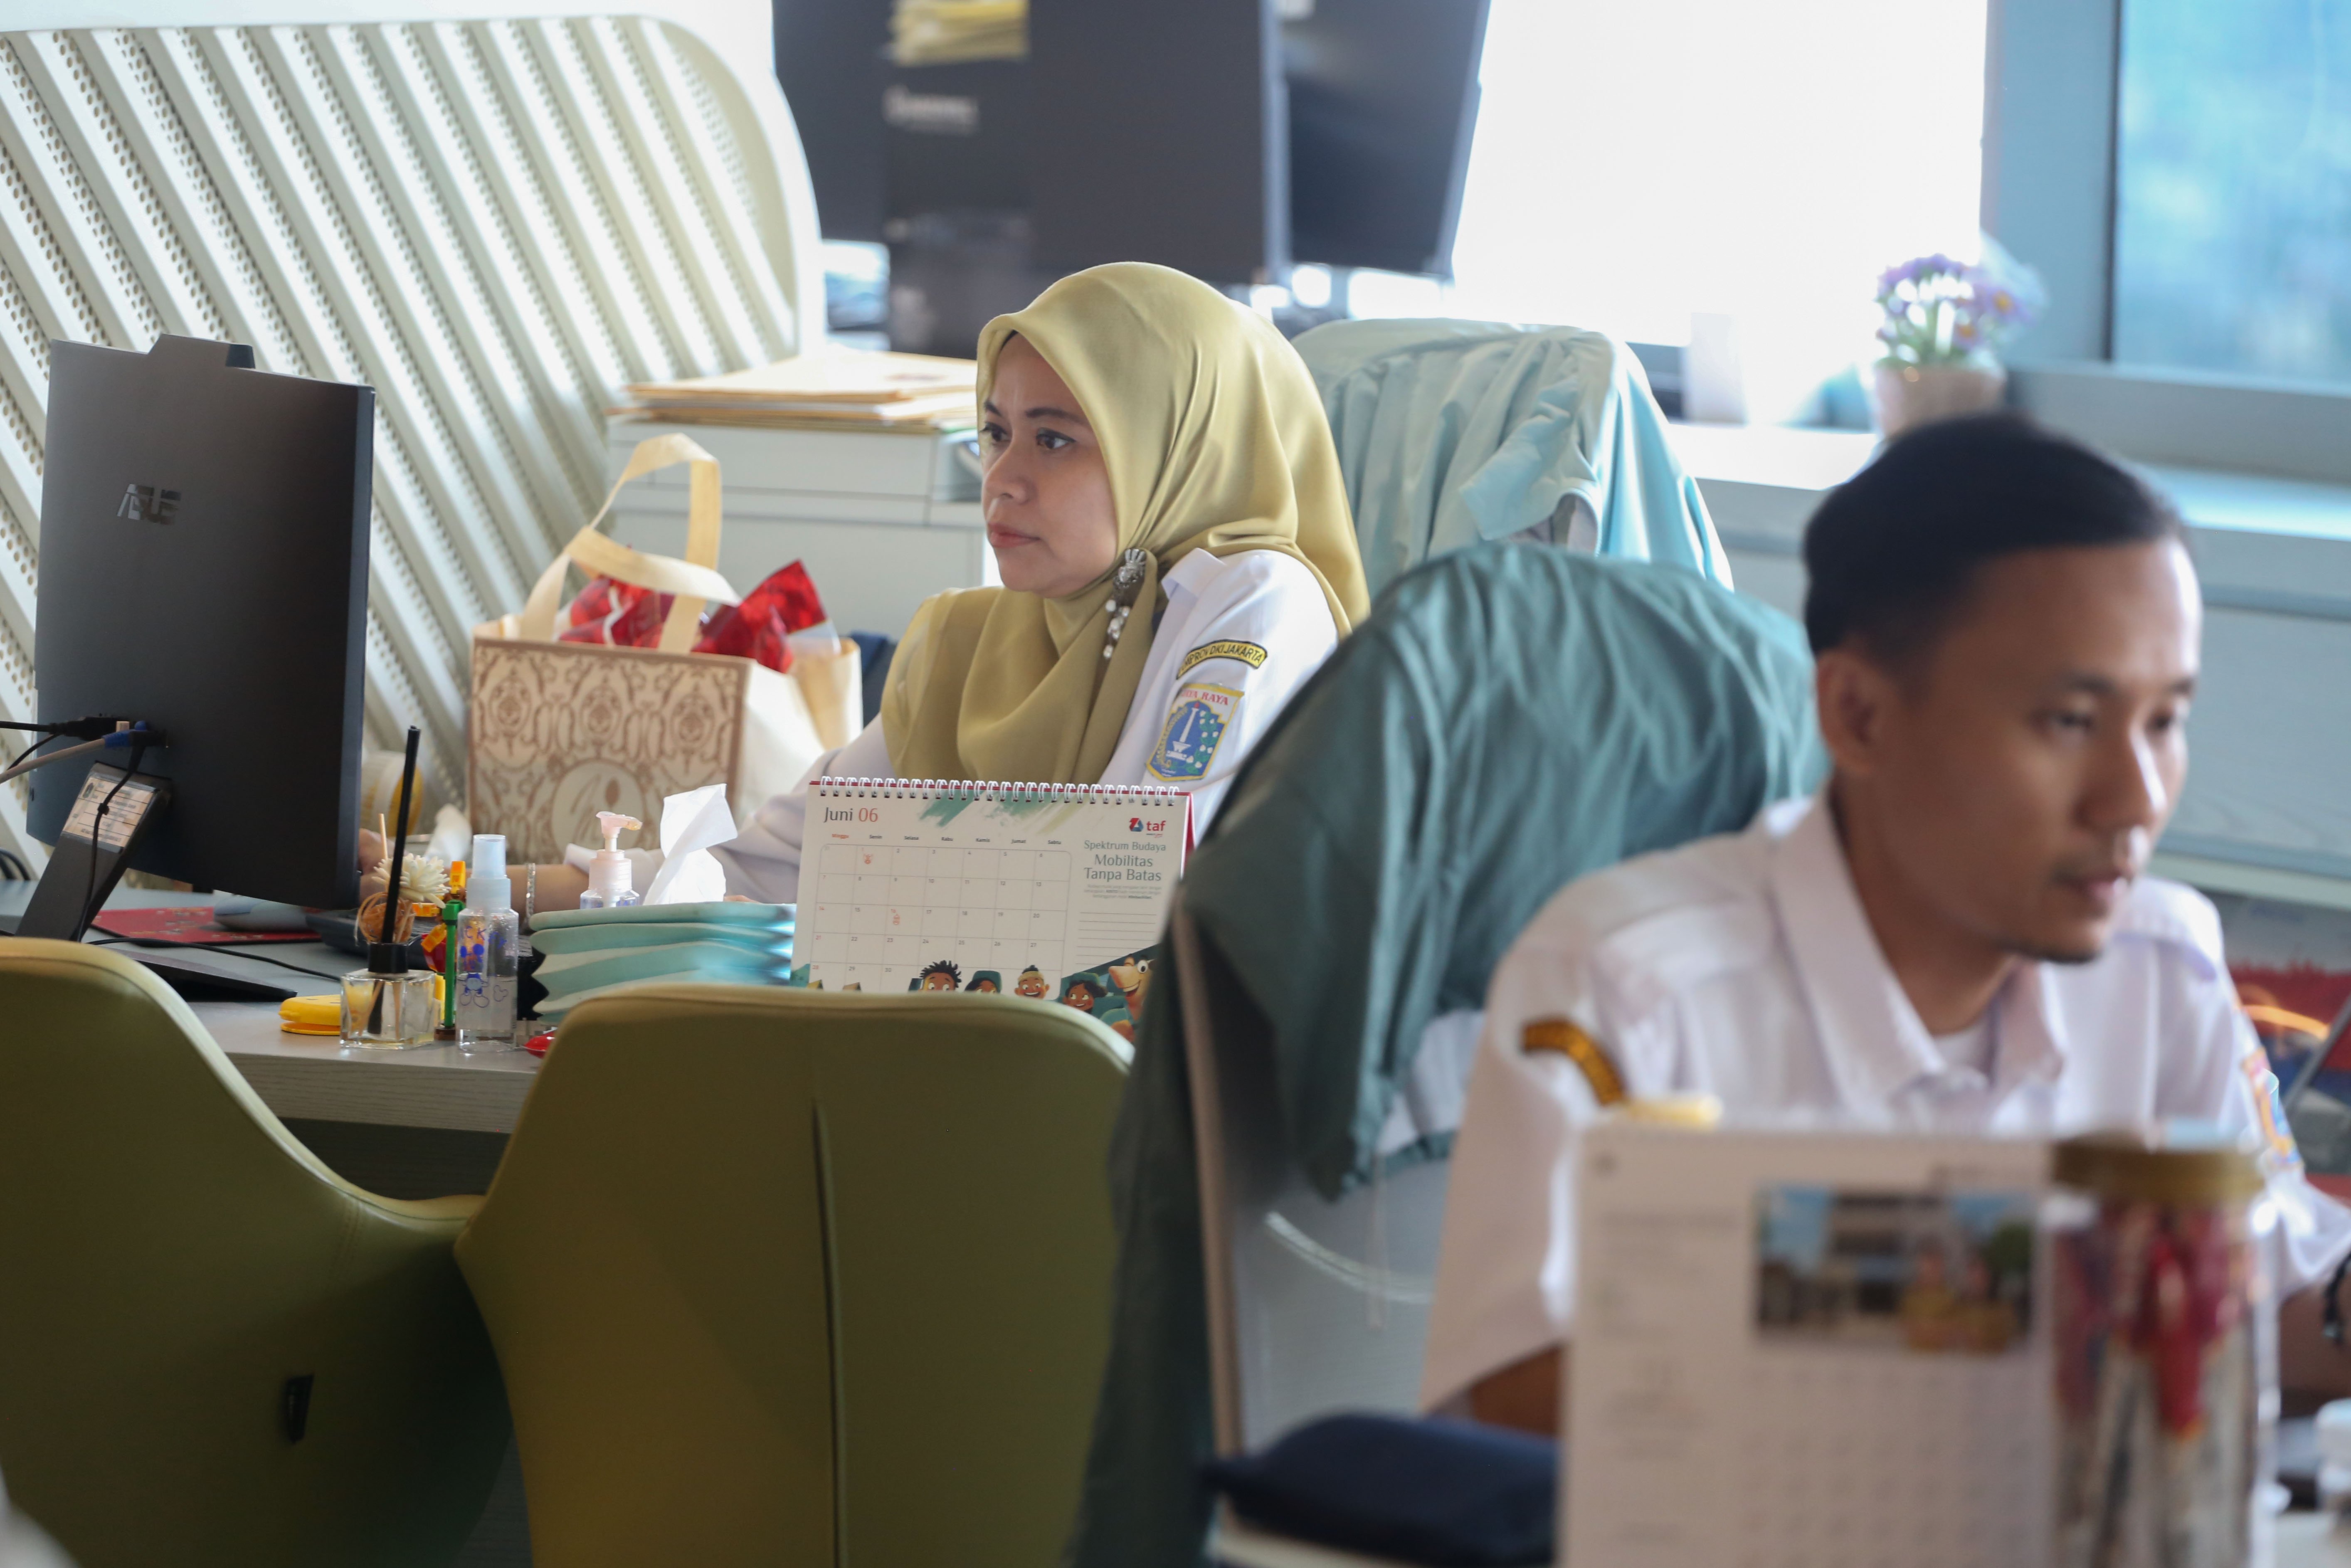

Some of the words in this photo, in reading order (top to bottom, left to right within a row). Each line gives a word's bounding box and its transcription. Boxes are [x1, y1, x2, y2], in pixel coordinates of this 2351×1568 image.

[1209, 645, 1224, 655] DKI
[1223, 645, 1263, 663] JAKARTA
[1202, 692, 1228, 705] RAYA
[824, 807, 853, 823] Juni
[858, 808, 878, 822] 06
[1146, 820, 1166, 831] taf
[1084, 840, 1129, 851] Spektrum
[1132, 841, 1166, 853] Budaya
[1094, 854, 1153, 867] Mobilitas
[1084, 868, 1122, 882] Tanpa
[1127, 869, 1162, 881] Batas
